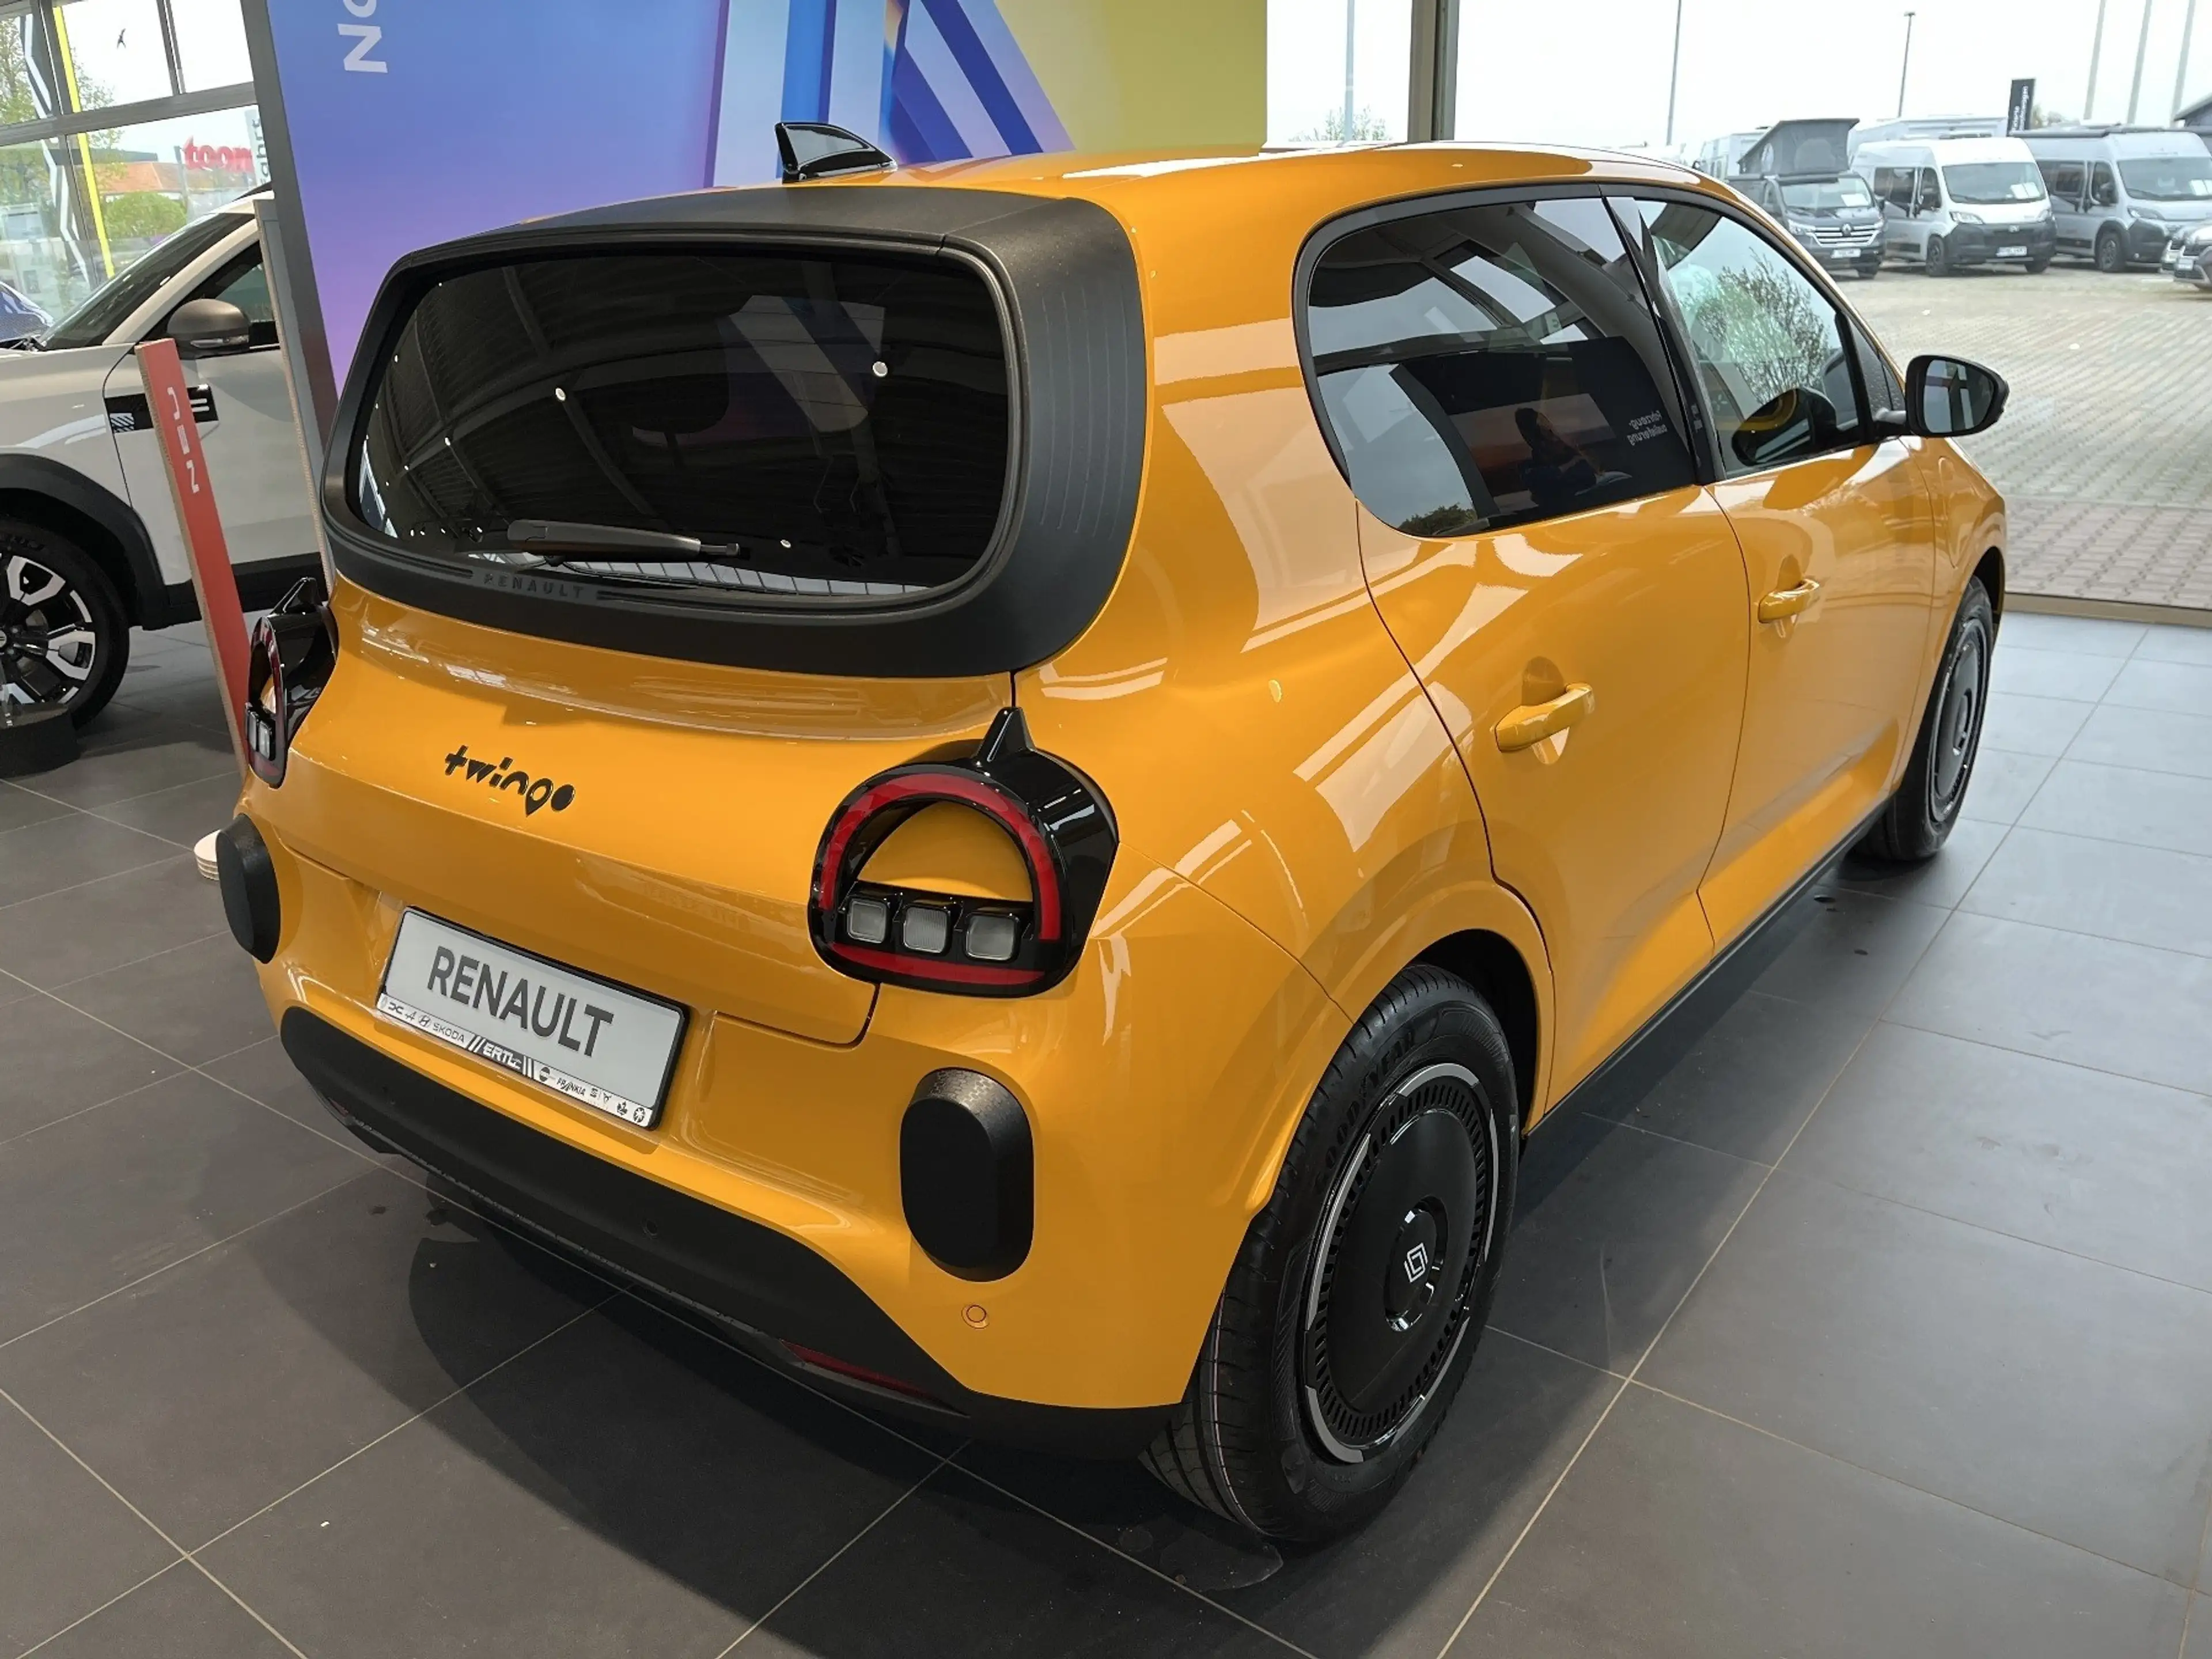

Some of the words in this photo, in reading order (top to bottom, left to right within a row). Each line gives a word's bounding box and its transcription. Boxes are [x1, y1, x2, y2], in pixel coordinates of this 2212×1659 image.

[483, 573, 585, 599] RENAULT
[445, 744, 576, 817] twingo
[427, 945, 614, 1057] RENAULT
